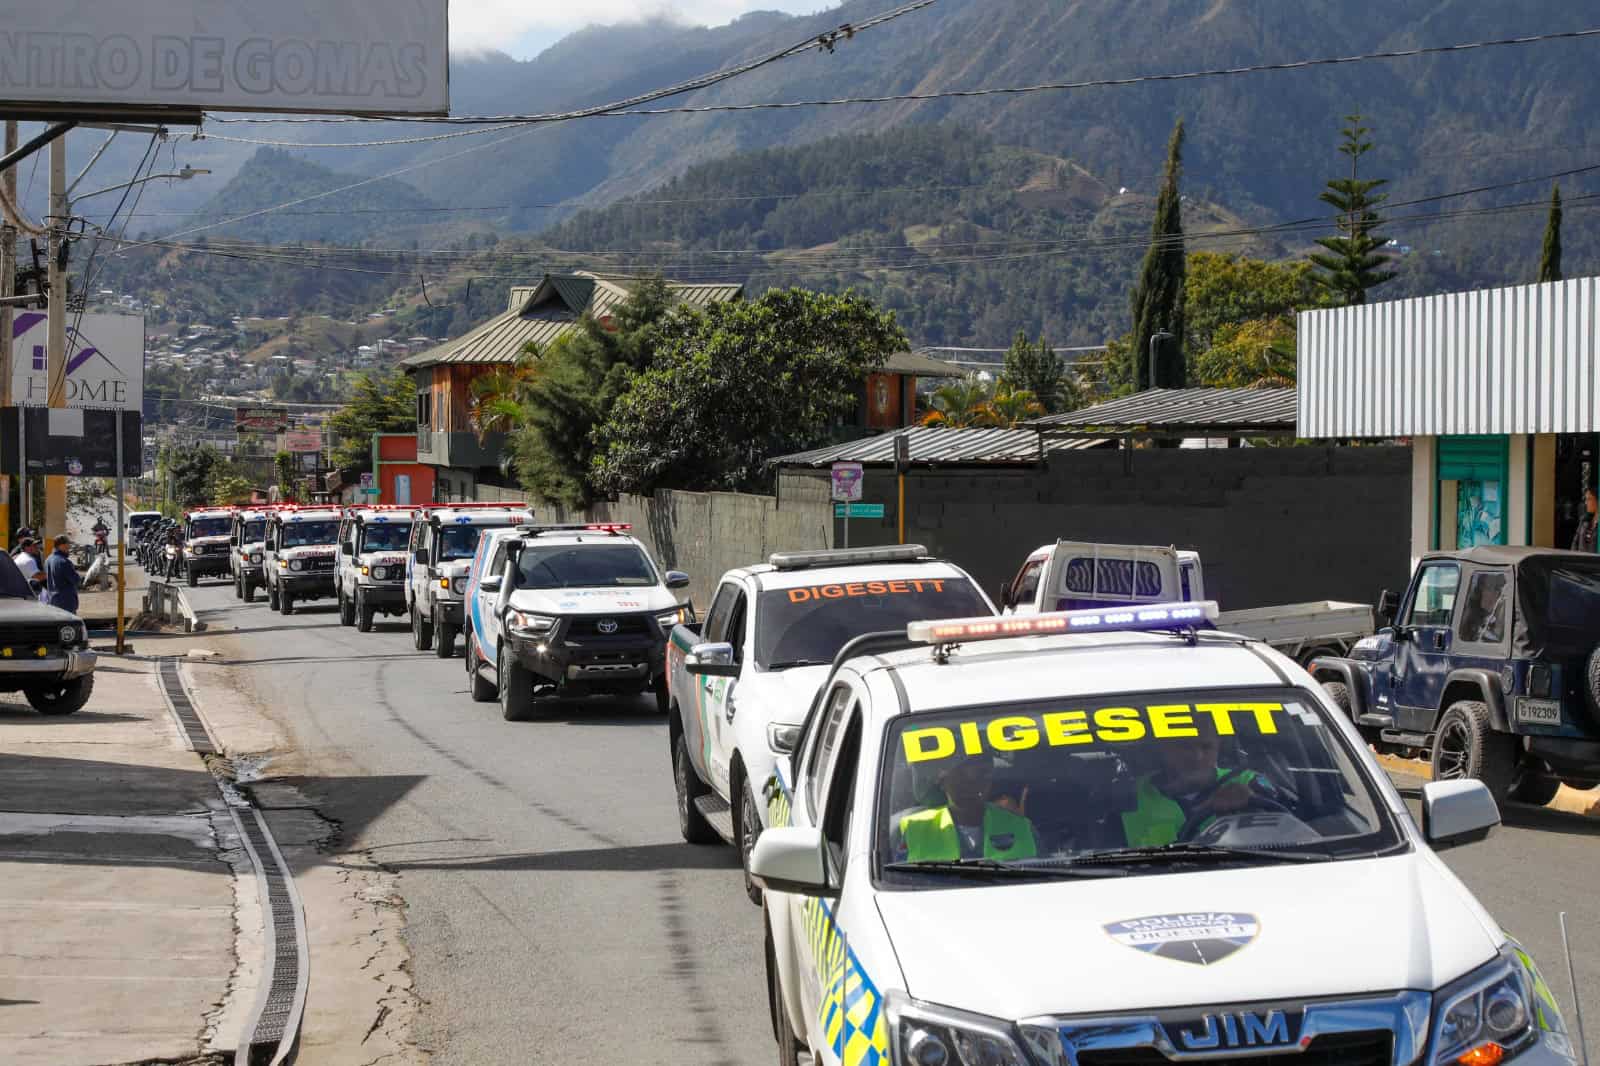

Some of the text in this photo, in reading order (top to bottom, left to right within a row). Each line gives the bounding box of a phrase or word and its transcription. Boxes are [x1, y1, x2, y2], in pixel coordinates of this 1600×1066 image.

[152, 37, 225, 92] DE
[234, 39, 428, 98] GOMAS
[788, 579, 945, 603] DIGESETT
[902, 703, 1283, 763] DIGESETT
[1180, 1008, 1289, 1049] JIM
